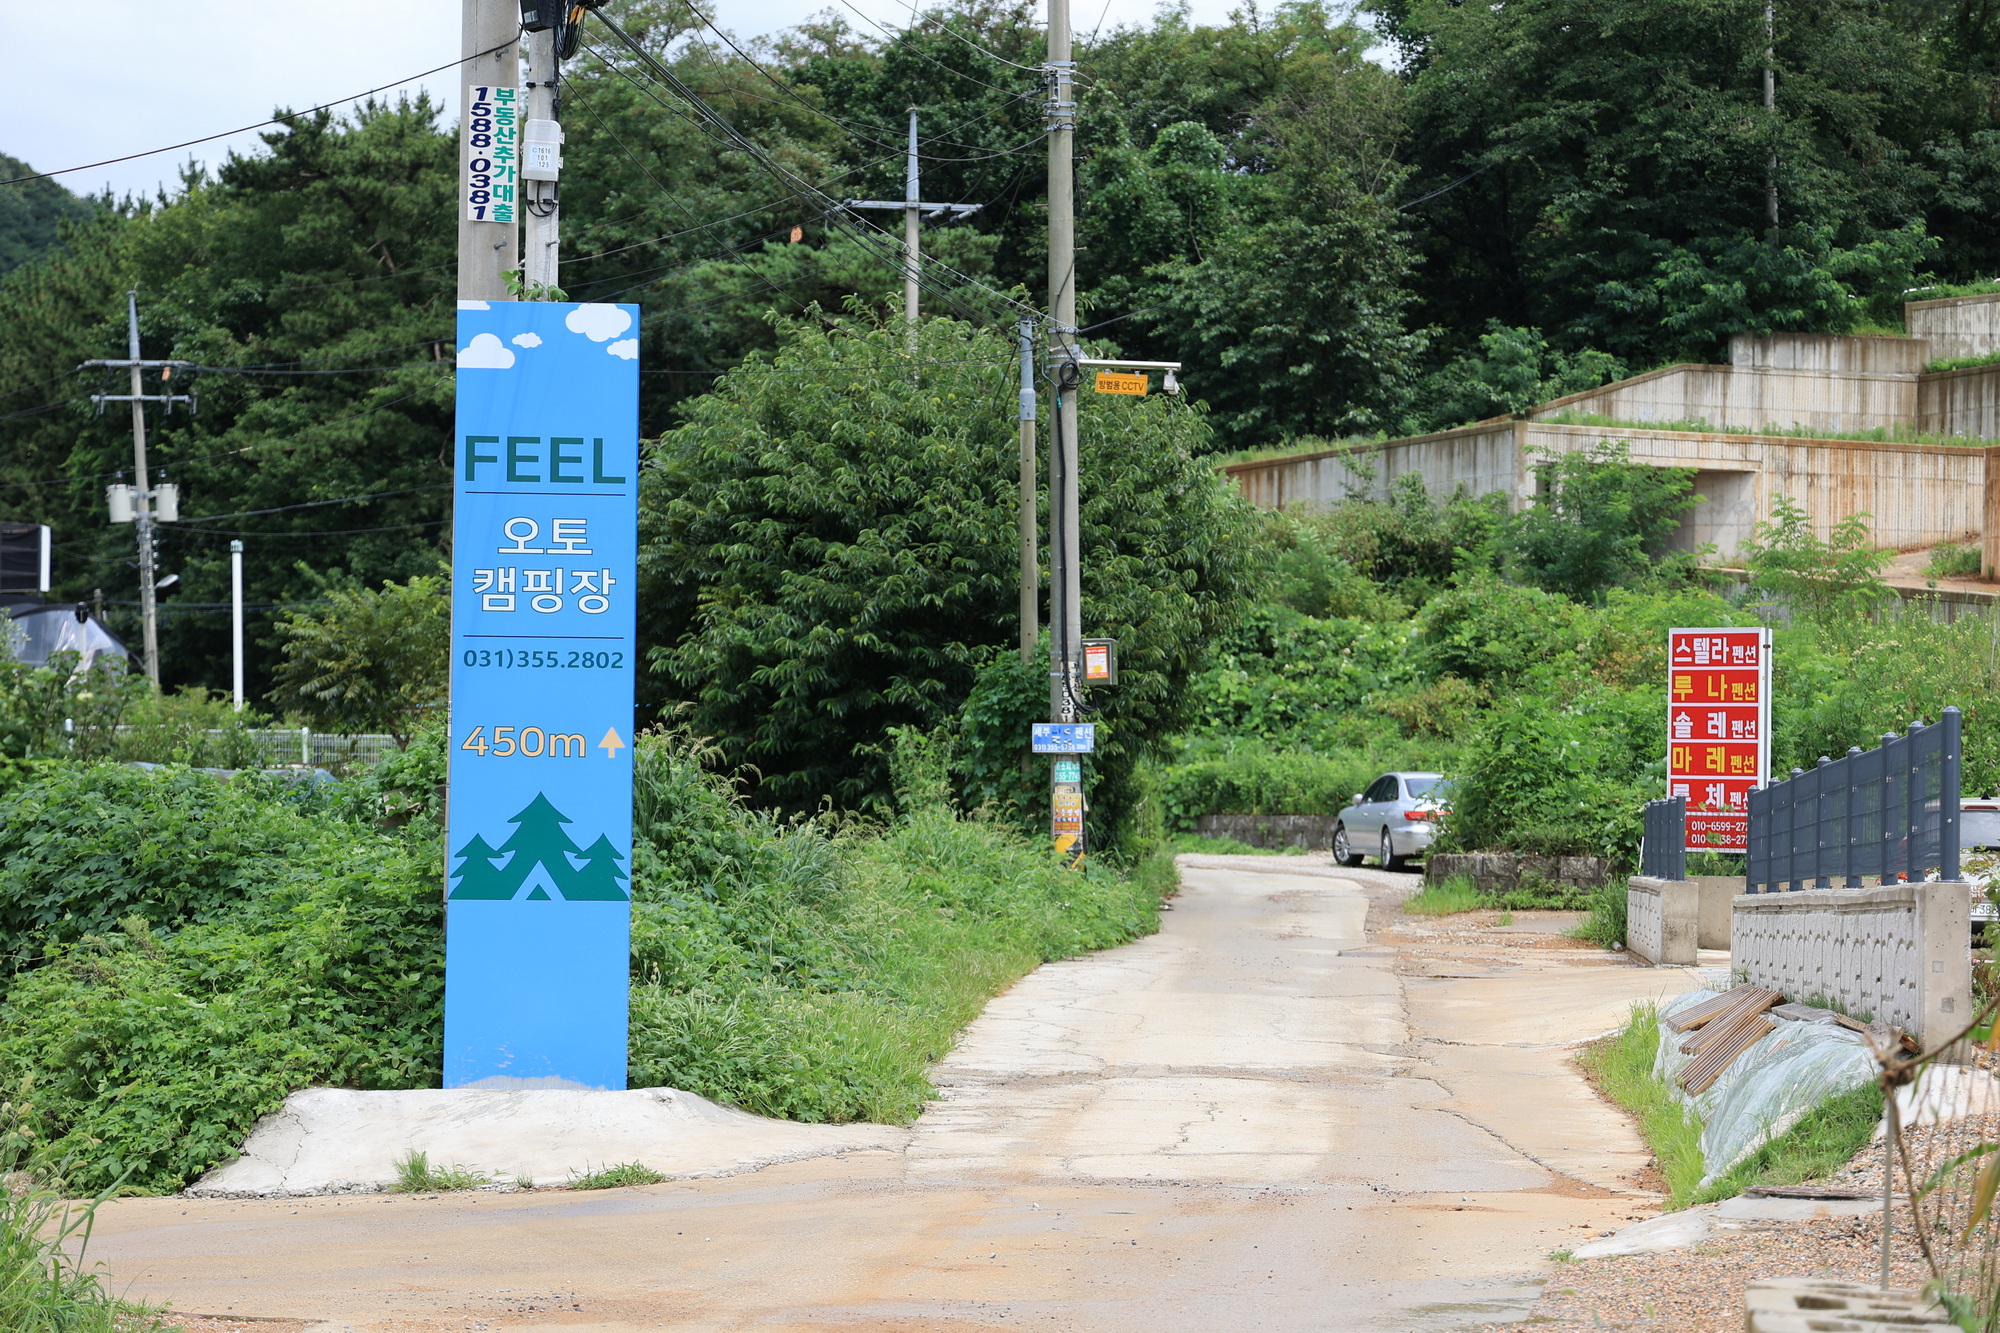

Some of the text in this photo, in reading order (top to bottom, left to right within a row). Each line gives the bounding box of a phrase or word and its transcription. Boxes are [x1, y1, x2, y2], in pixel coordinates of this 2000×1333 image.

[1099, 380, 1144, 391] 방범용 CCTV
[465, 435, 626, 484] FEEL
[498, 517, 593, 555] 오토
[473, 567, 616, 614] 캠핑장
[464, 649, 624, 669] 031)355.2802
[1674, 637, 1756, 664] 스텔라 펜션
[1731, 682, 1756, 701] 펜션
[1731, 720, 1756, 738] 펜션
[461, 726, 587, 757] 450m
[1730, 755, 1754, 773] 펜션
